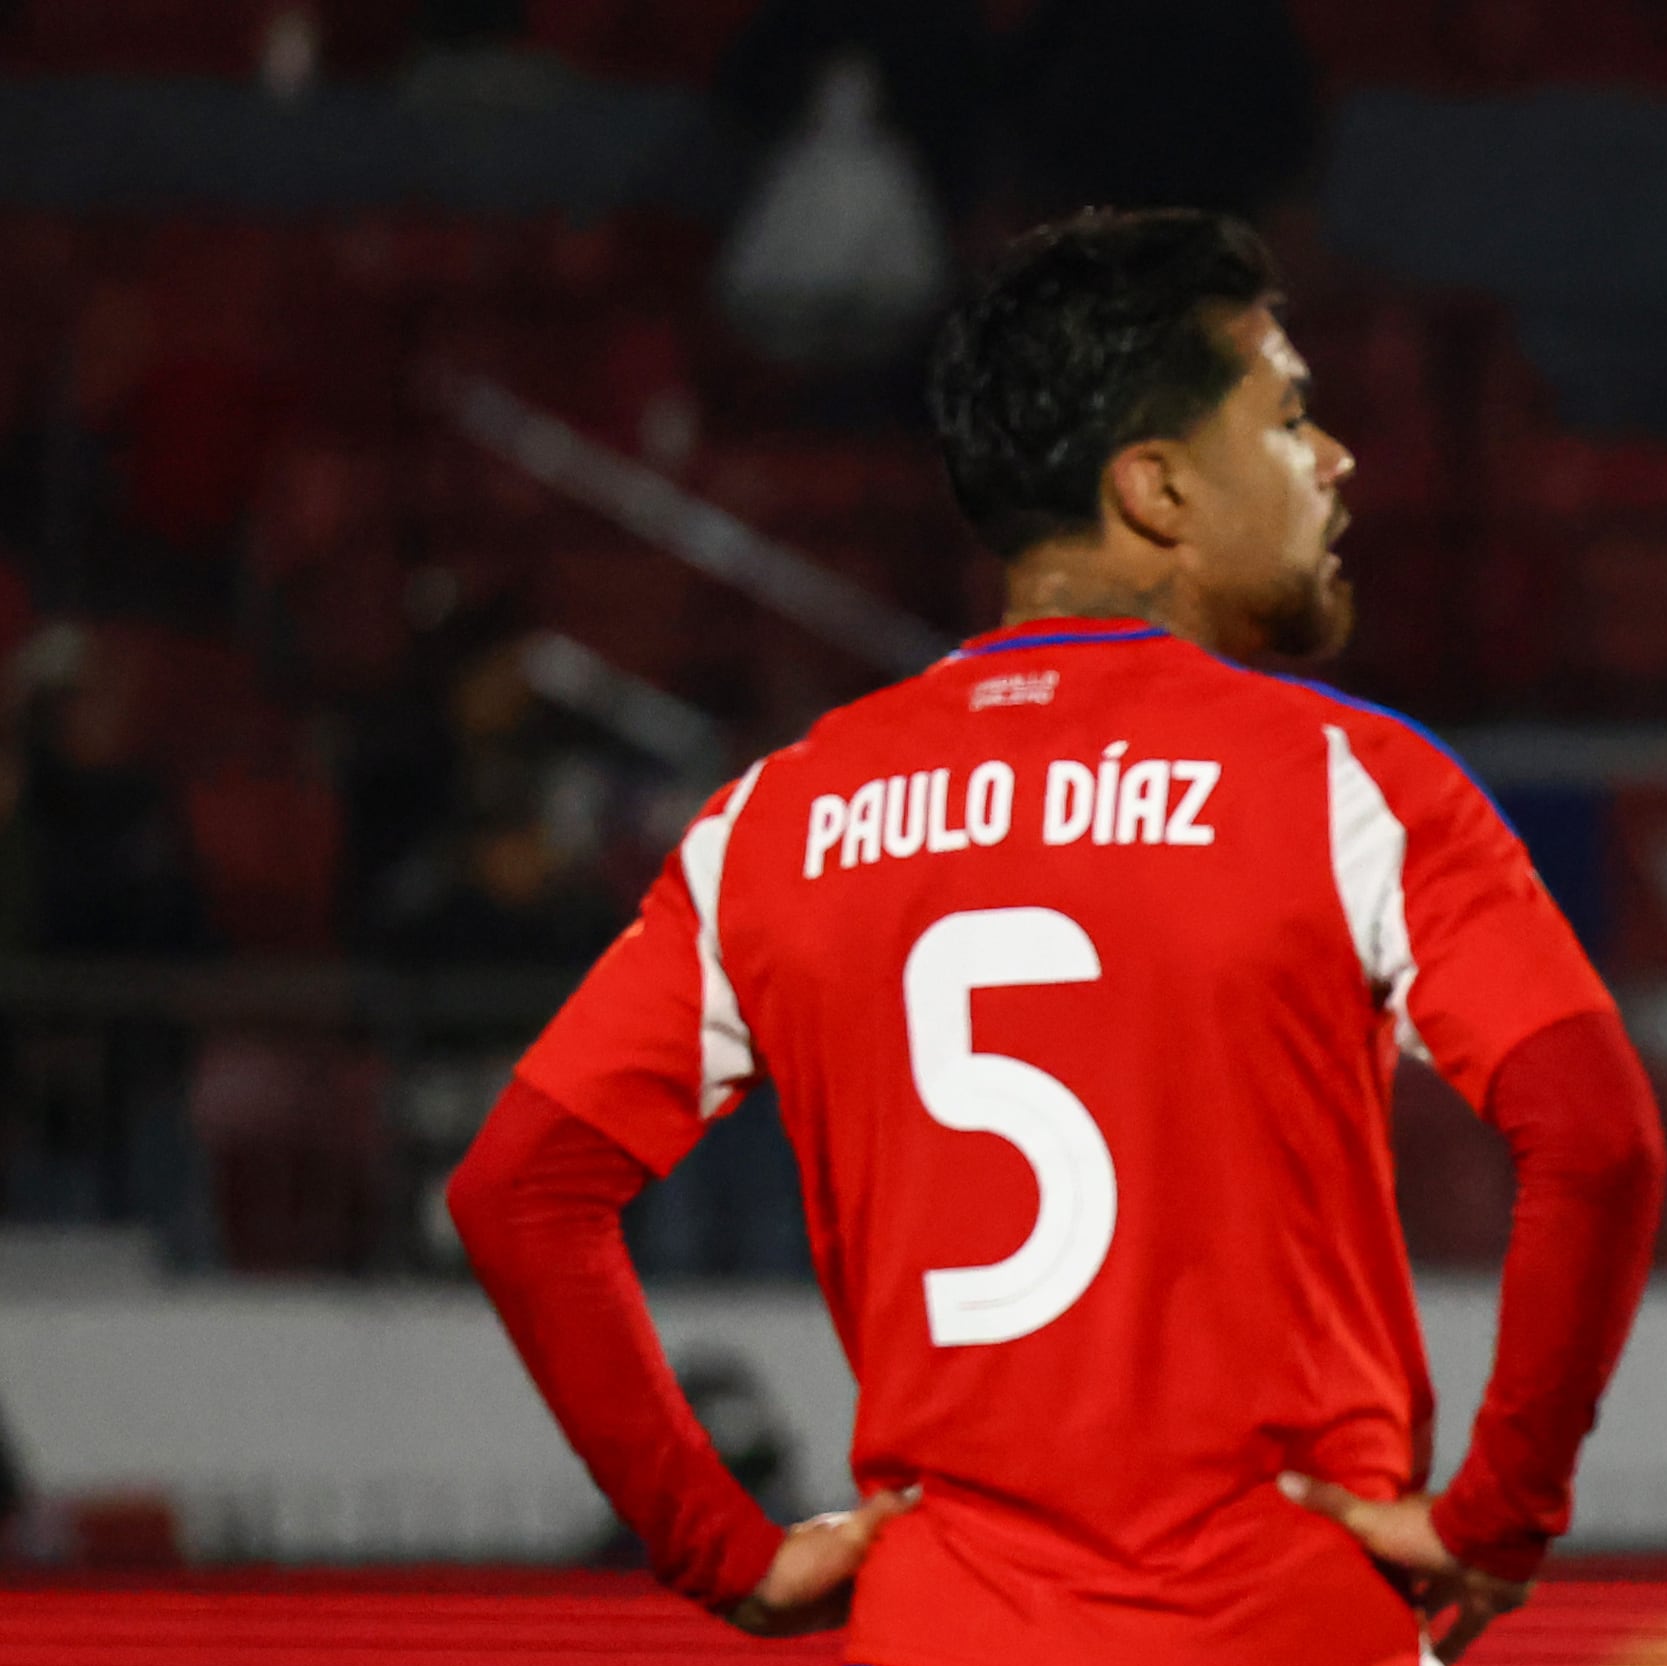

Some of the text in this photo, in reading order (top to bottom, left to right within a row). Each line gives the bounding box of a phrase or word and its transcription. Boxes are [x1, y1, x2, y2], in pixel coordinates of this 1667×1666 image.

[803, 740, 1222, 879] PAULO DÍAZ
[903, 905, 1118, 1347] 5
